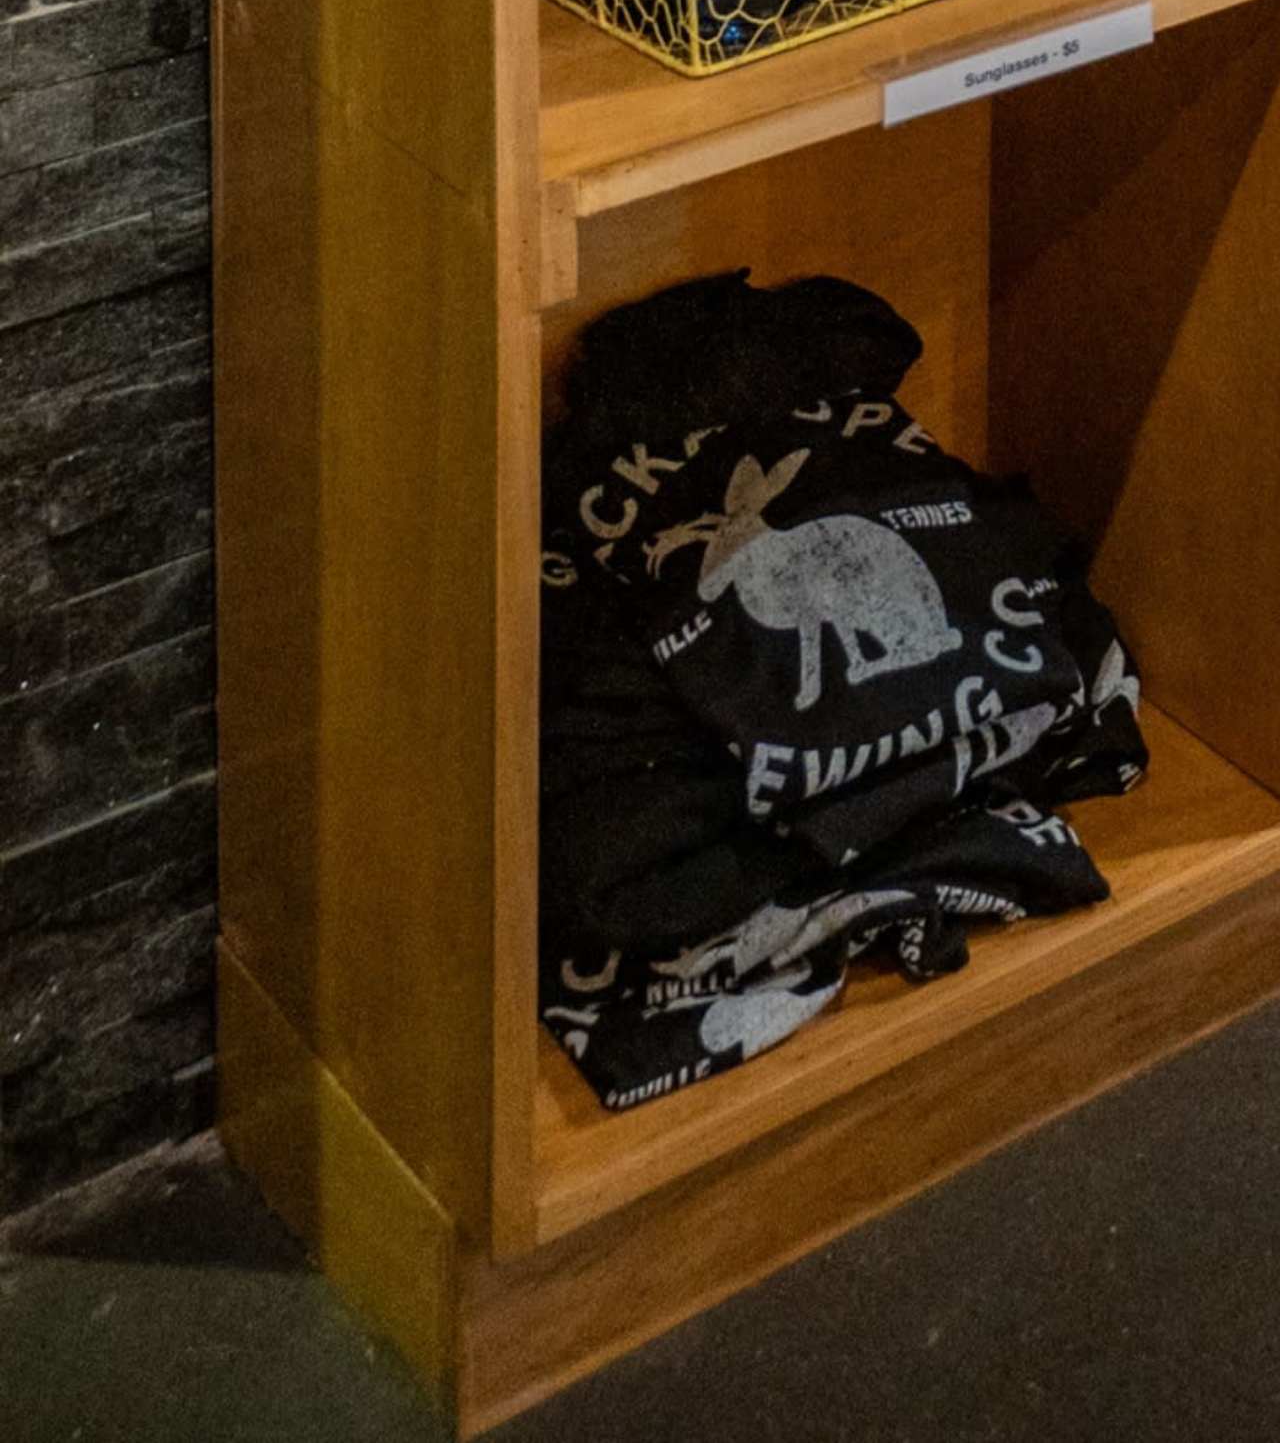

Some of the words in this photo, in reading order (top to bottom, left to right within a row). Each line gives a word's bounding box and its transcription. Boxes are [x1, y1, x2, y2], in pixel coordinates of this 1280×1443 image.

[963, 51, 1049, 89] Sunglasses
[1062, 39, 1080, 58] $5
[880, 500, 974, 530] TENNES
[745, 673, 1004, 818] EWING
